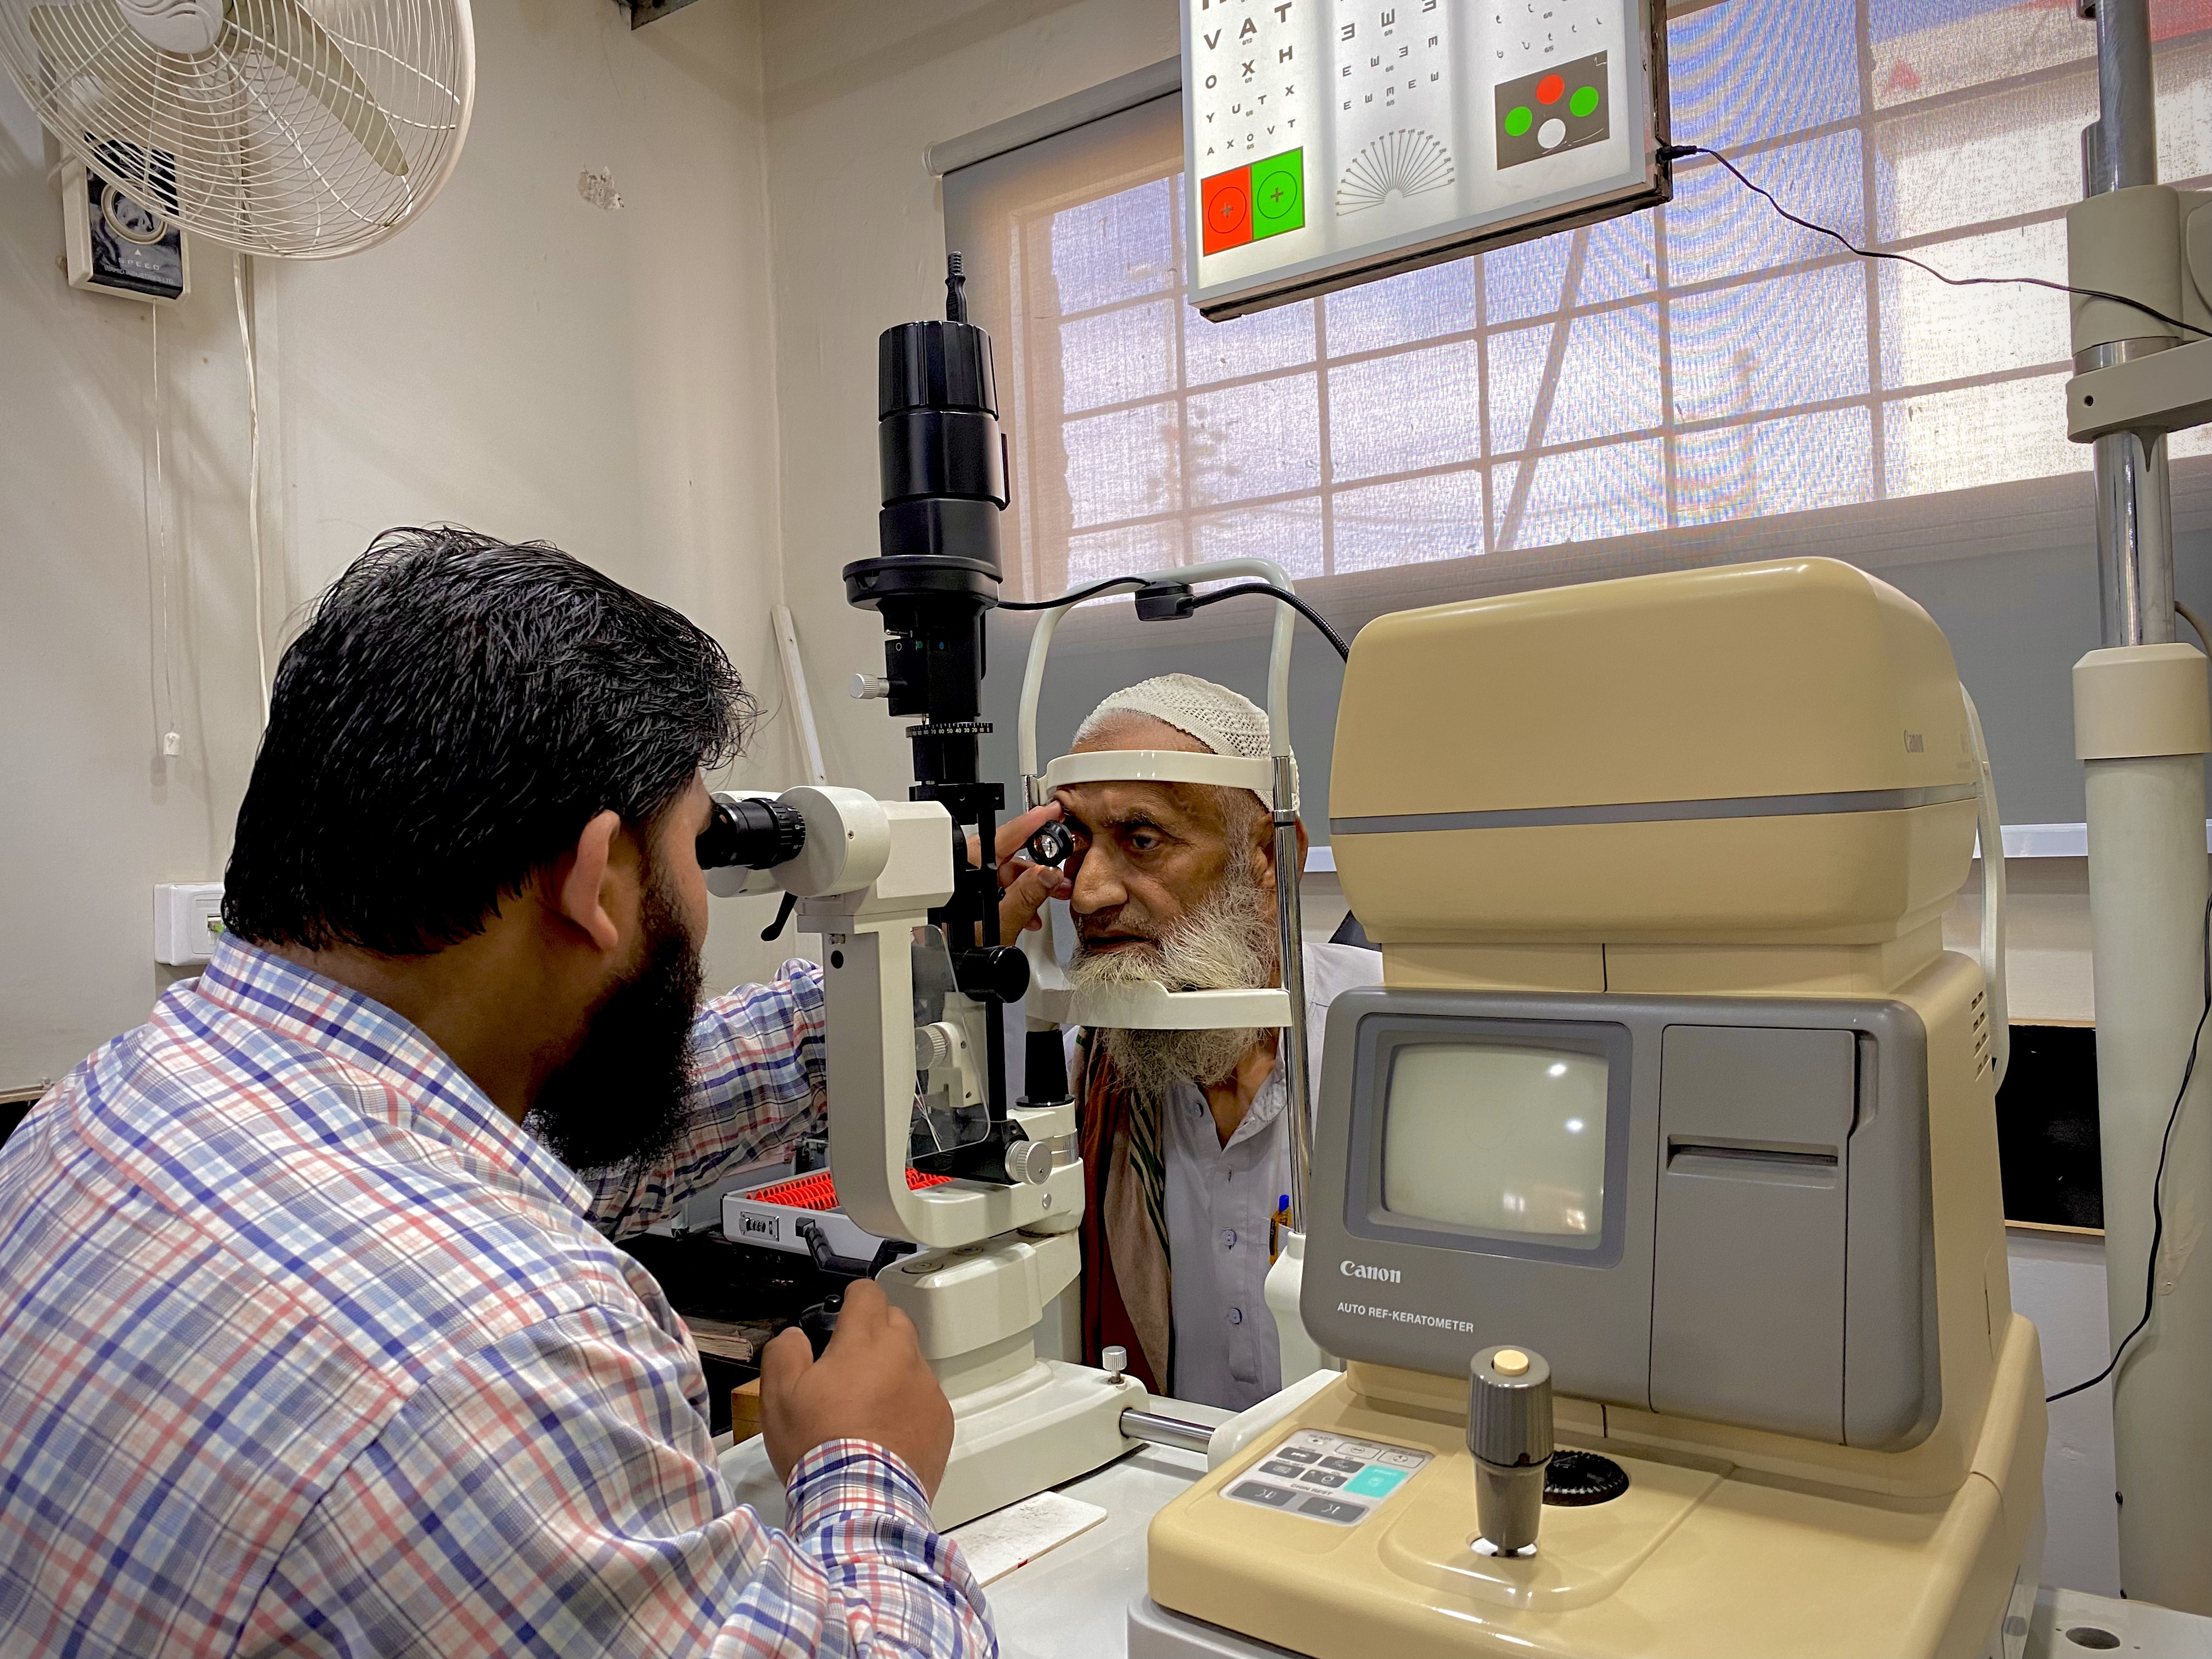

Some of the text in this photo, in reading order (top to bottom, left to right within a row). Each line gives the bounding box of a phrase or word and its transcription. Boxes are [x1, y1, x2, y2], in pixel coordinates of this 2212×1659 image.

[1204, 2, 1292, 50] V A T
[1205, 46, 1293, 89] O X H
[1206, 85, 1294, 123] Y U T X
[1207, 119, 1295, 155] A X O V T
[118, 257, 160, 270] SPEED
[1340, 1260, 1401, 1283] Canon
[1337, 1302, 1474, 1333] AUTO REF-KERATOMETER
[1290, 1483, 1334, 1496] CHIN REST
